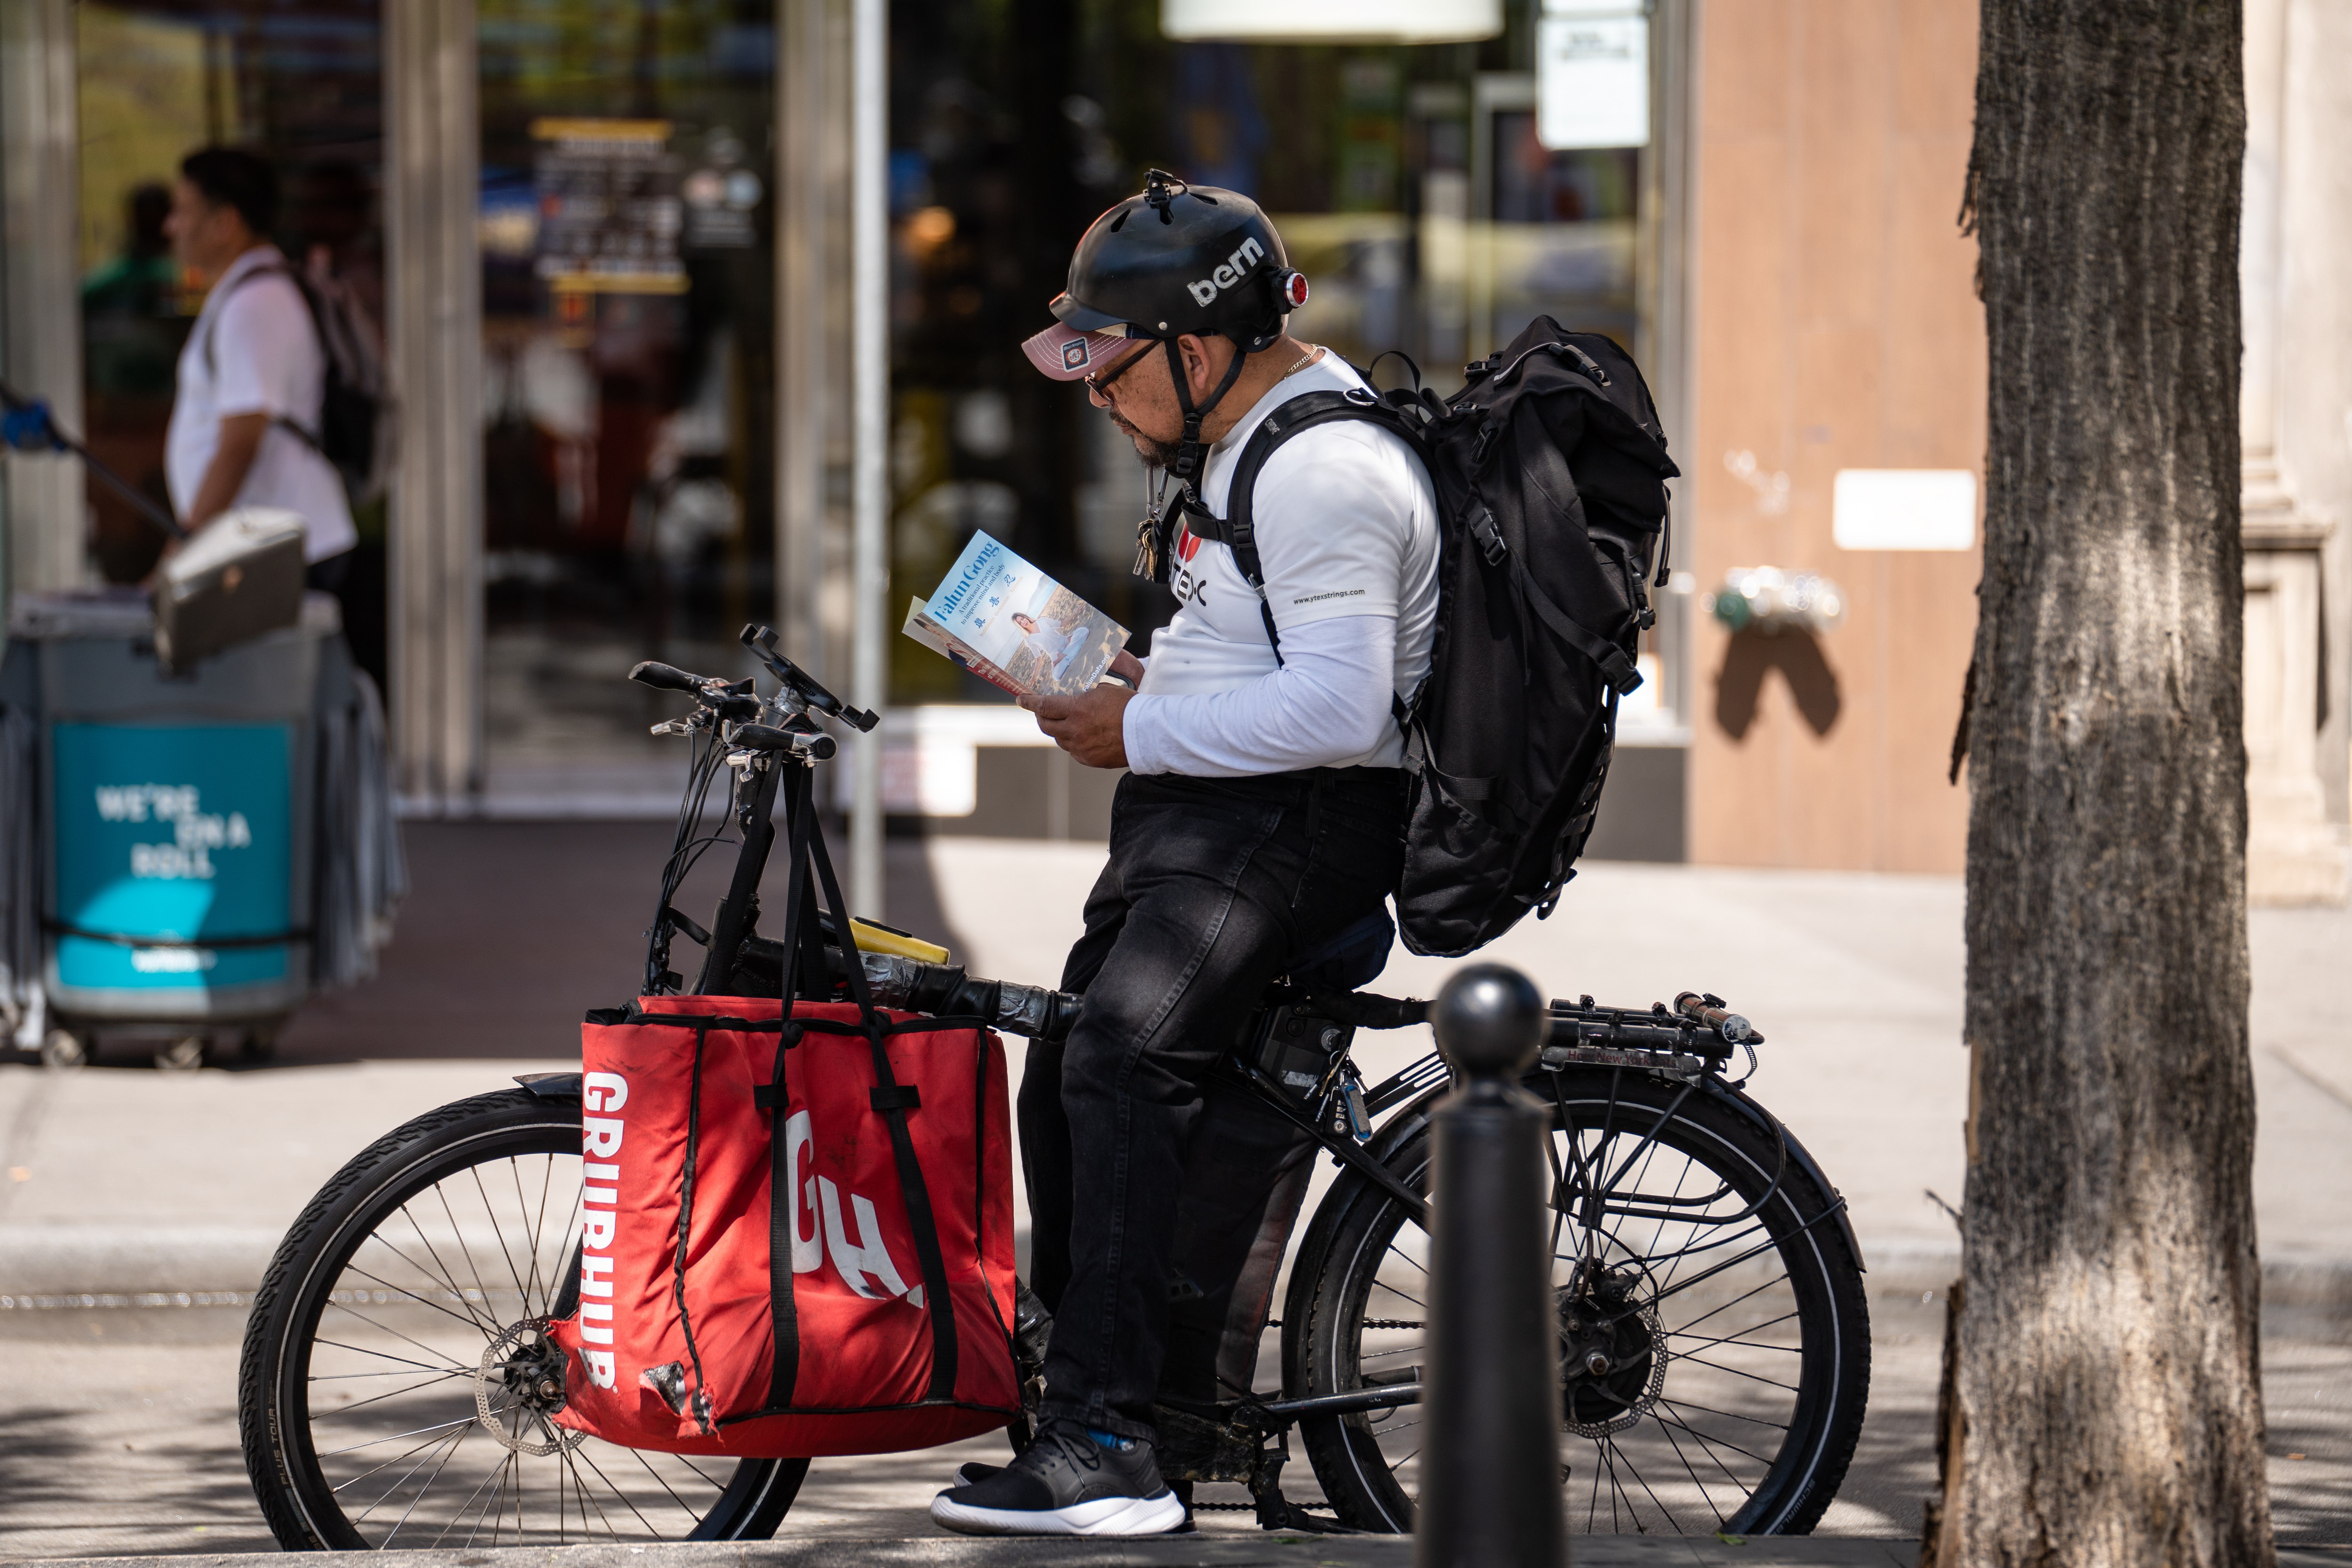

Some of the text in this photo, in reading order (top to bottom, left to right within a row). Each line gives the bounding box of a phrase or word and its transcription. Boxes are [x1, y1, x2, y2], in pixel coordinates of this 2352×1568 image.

[1187, 237, 1264, 307] bern
[1265, 418, 1280, 435] CHROME
[934, 580, 971, 622] Falun
[963, 541, 1000, 580] Gong
[962, 584, 981, 611] traditional
[979, 565, 995, 587] practice
[965, 599, 980, 619] improve
[979, 585, 990, 600] mind
[988, 575, 996, 587] and
[994, 563, 1005, 576] body
[989, 596, 1000, 607] 善
[1004, 574, 1016, 587] 忍
[1294, 589, 1365, 605] www.ytexstrings.com
[979, 617, 995, 637] Truthfulness
[994, 596, 1009, 616] Compassion
[1082, 654, 1111, 692] FalunDafa.org
[227, 812, 252, 849] A
[1597, 1052, 1623, 1063] New
[1625, 1054, 1650, 1065] York
[579, 1072, 628, 1389] GRUBHUB
[269, 1408, 289, 1485] PLUS TOUR
